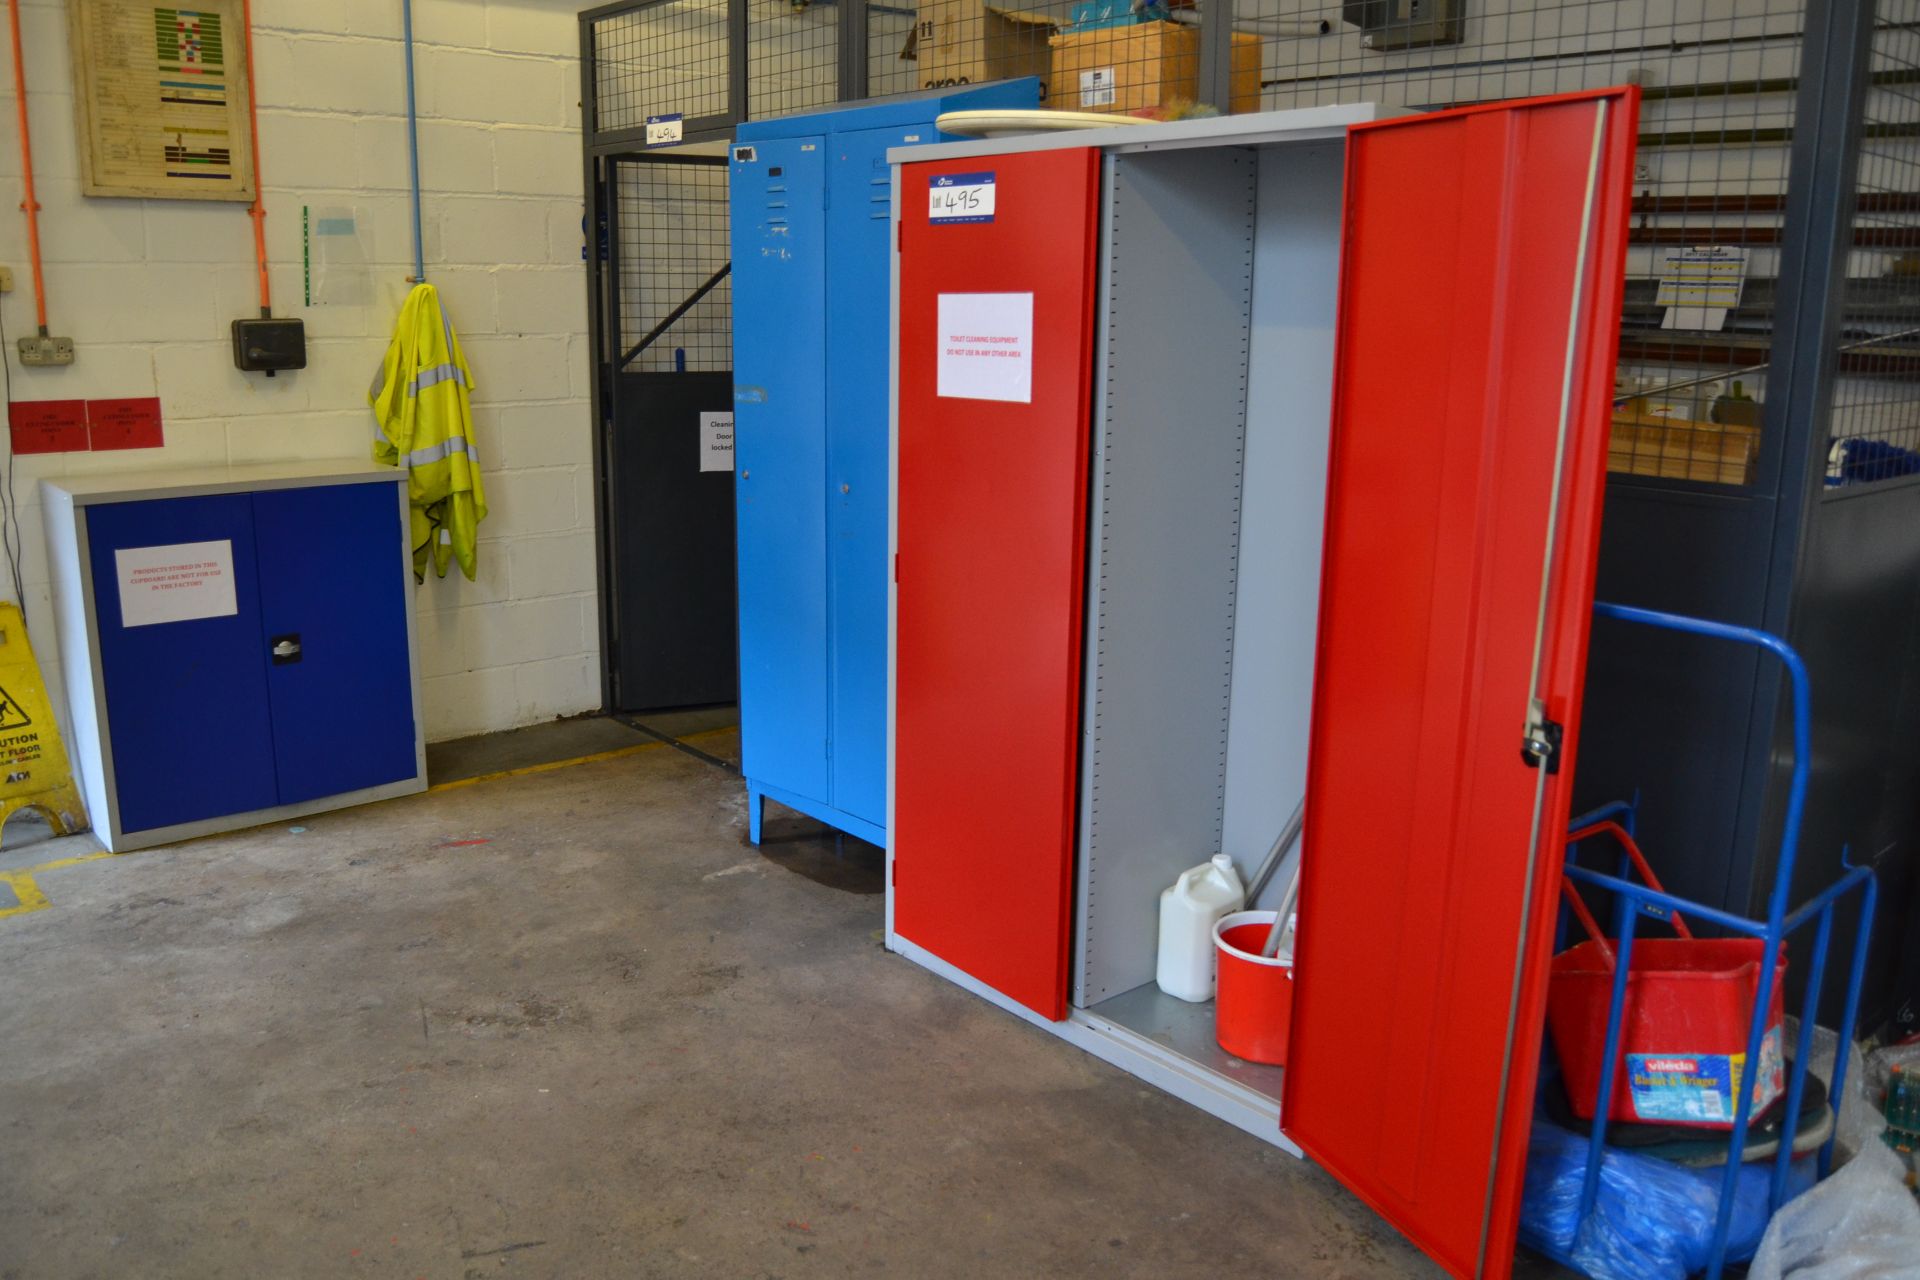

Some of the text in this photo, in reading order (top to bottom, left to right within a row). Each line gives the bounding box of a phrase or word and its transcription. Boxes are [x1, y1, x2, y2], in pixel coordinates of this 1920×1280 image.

[657, 127, 677, 142] 494
[945, 187, 982, 213] 495
[133, 567, 168, 575] PRODUCTS
[168, 564, 194, 572] STORED
[130, 576, 166, 585] CUPBOARD
[174, 580, 203, 589] FACTORY
[8, 744, 41, 757] FLOOR
[1648, 1059, 1695, 1072] vileda
